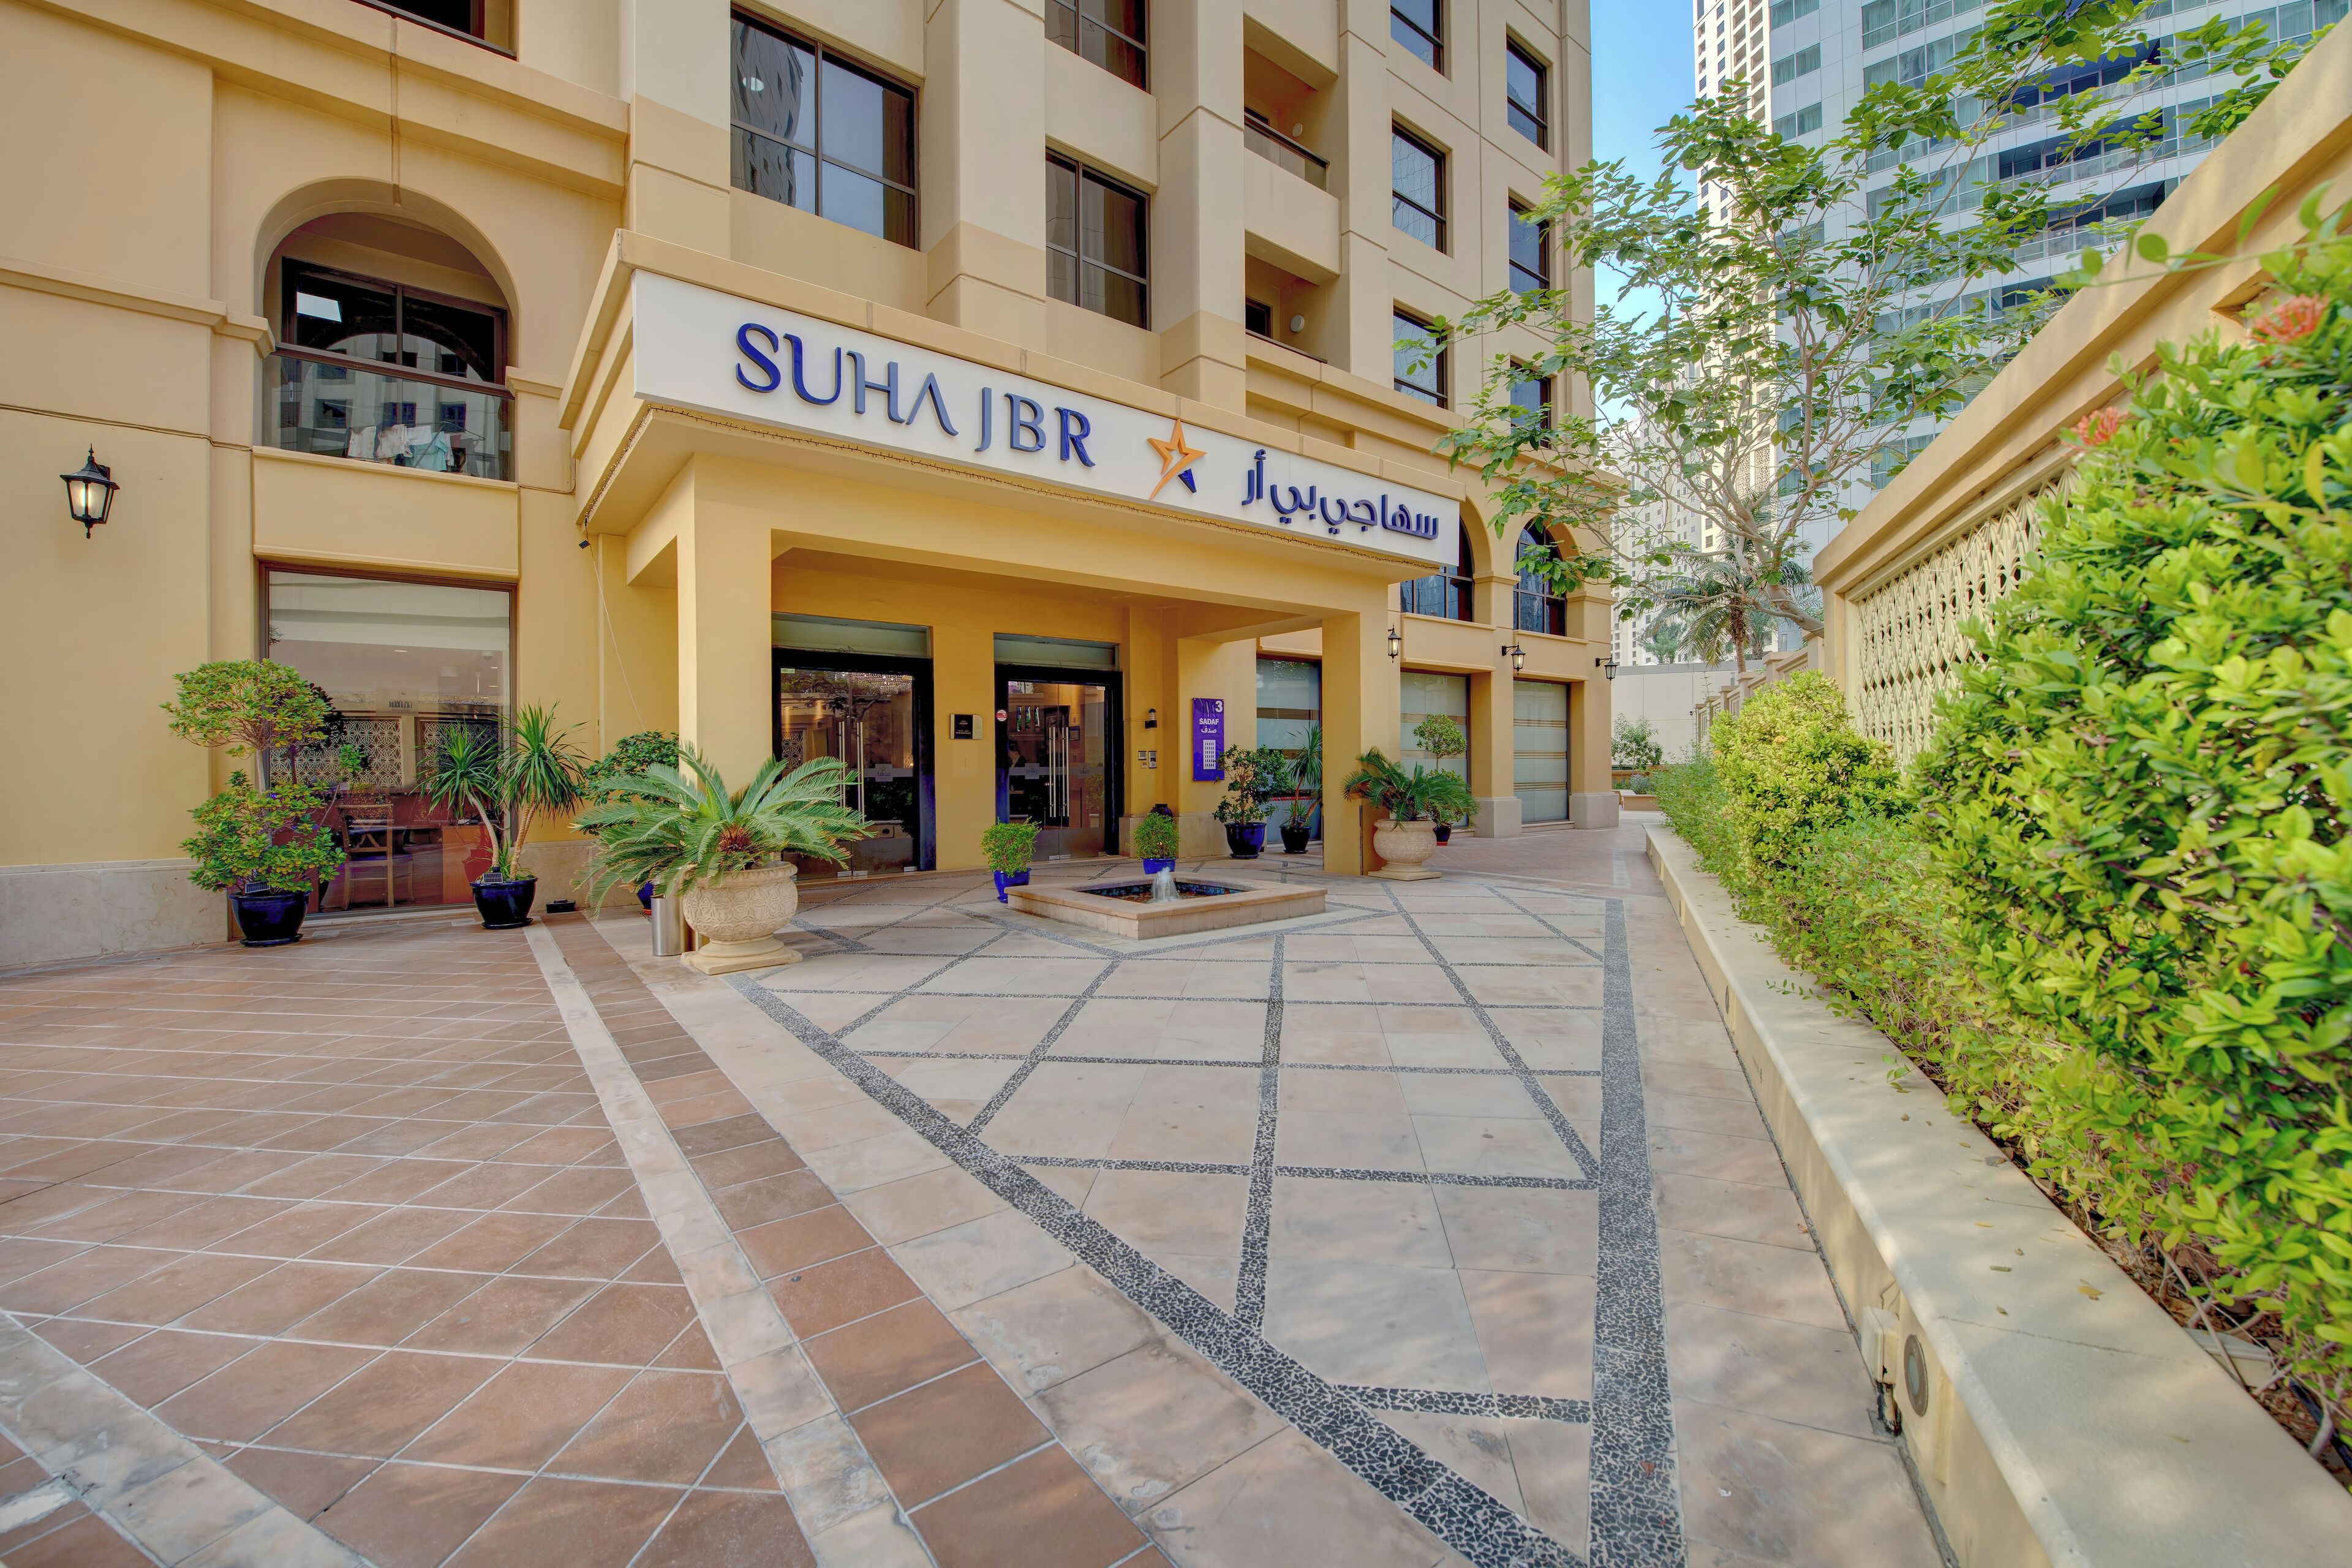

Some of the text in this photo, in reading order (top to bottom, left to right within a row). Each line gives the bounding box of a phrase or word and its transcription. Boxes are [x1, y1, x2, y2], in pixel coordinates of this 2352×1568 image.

[735, 323, 1096, 468] SUHA JBR
[1215, 701, 1223, 712] 3
